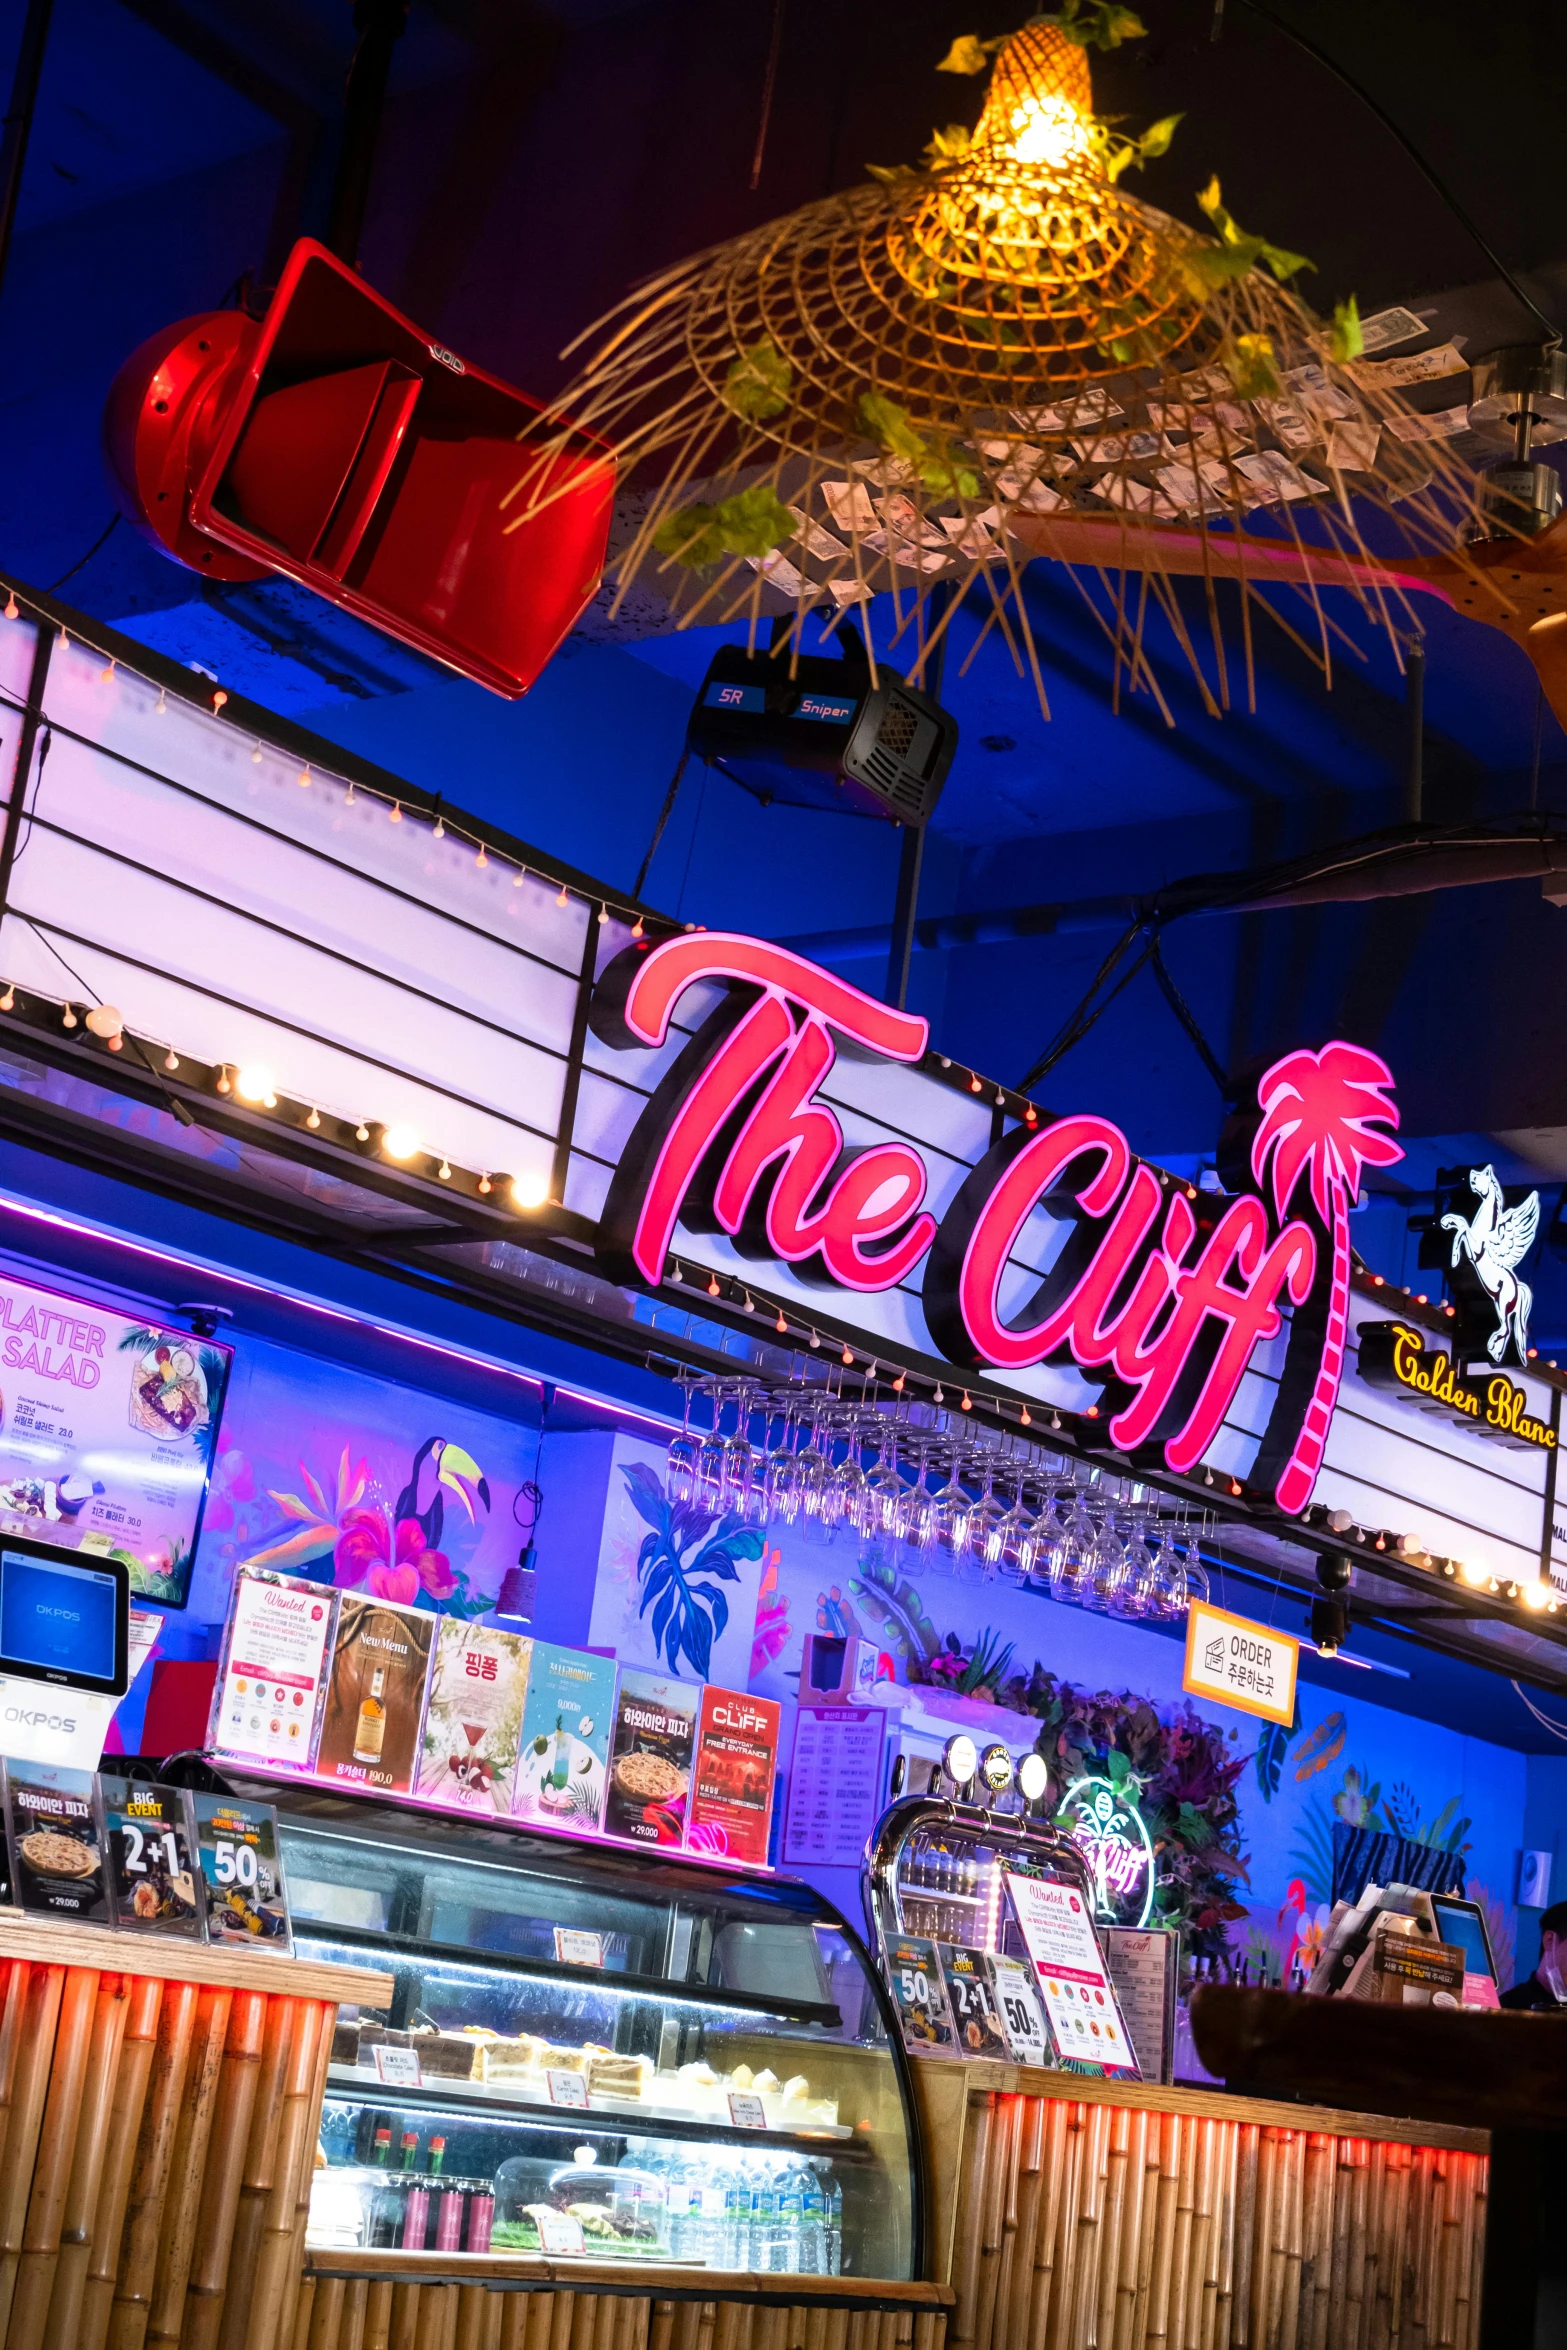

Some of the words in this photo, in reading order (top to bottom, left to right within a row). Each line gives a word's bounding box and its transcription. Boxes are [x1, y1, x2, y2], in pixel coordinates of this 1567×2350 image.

[434, 344, 464, 374] VOID
[800, 699, 849, 719] Sniper
[624, 929, 938, 1293] The
[959, 1113, 1318, 1474] Cliff
[1, 1336, 101, 1389] SALAD
[1392, 1325, 1481, 1417] Golden
[1486, 1376, 1557, 1449] Blanc
[15, 1403, 36, 1418] 코코넛
[91, 1506, 105, 1518] 치즈
[126, 1516, 142, 1527] 30.0
[264, 1590, 307, 1613] Wanted
[360, 1631, 380, 1648] New
[380, 1637, 408, 1655] Menu
[1230, 1635, 1272, 1669] ORDER
[465, 1652, 499, 1682] 핑퐁
[1227, 1661, 1275, 1698] 주문하는곳
[728, 1702, 755, 1714] CLUB
[4, 1707, 78, 1733] OKPOS
[623, 1707, 667, 1733] 하와이안
[666, 1718, 689, 1739] 피자
[713, 1725, 741, 1736] GRAND
[742, 1731, 765, 1743] OPEN
[722, 1736, 754, 1749] EVERYDAY
[706, 1738, 726, 1750] FREE
[727, 1744, 768, 1760] ENTRANCE
[17, 1791, 63, 1815] 하와이안
[65, 1801, 89, 1819] 피자
[127, 1803, 163, 1816] EVENT
[133, 1792, 155, 1805] BIG
[121, 1824, 180, 1878] 2+1
[1029, 1884, 1064, 1906] Wanted
[953, 1961, 974, 1972] EVENT
[955, 1953, 969, 1963] BIG
[1384, 1961, 1397, 1972] 사용
[1397, 1965, 1404, 1973] 후
[952, 1978, 990, 2017] 2+1
